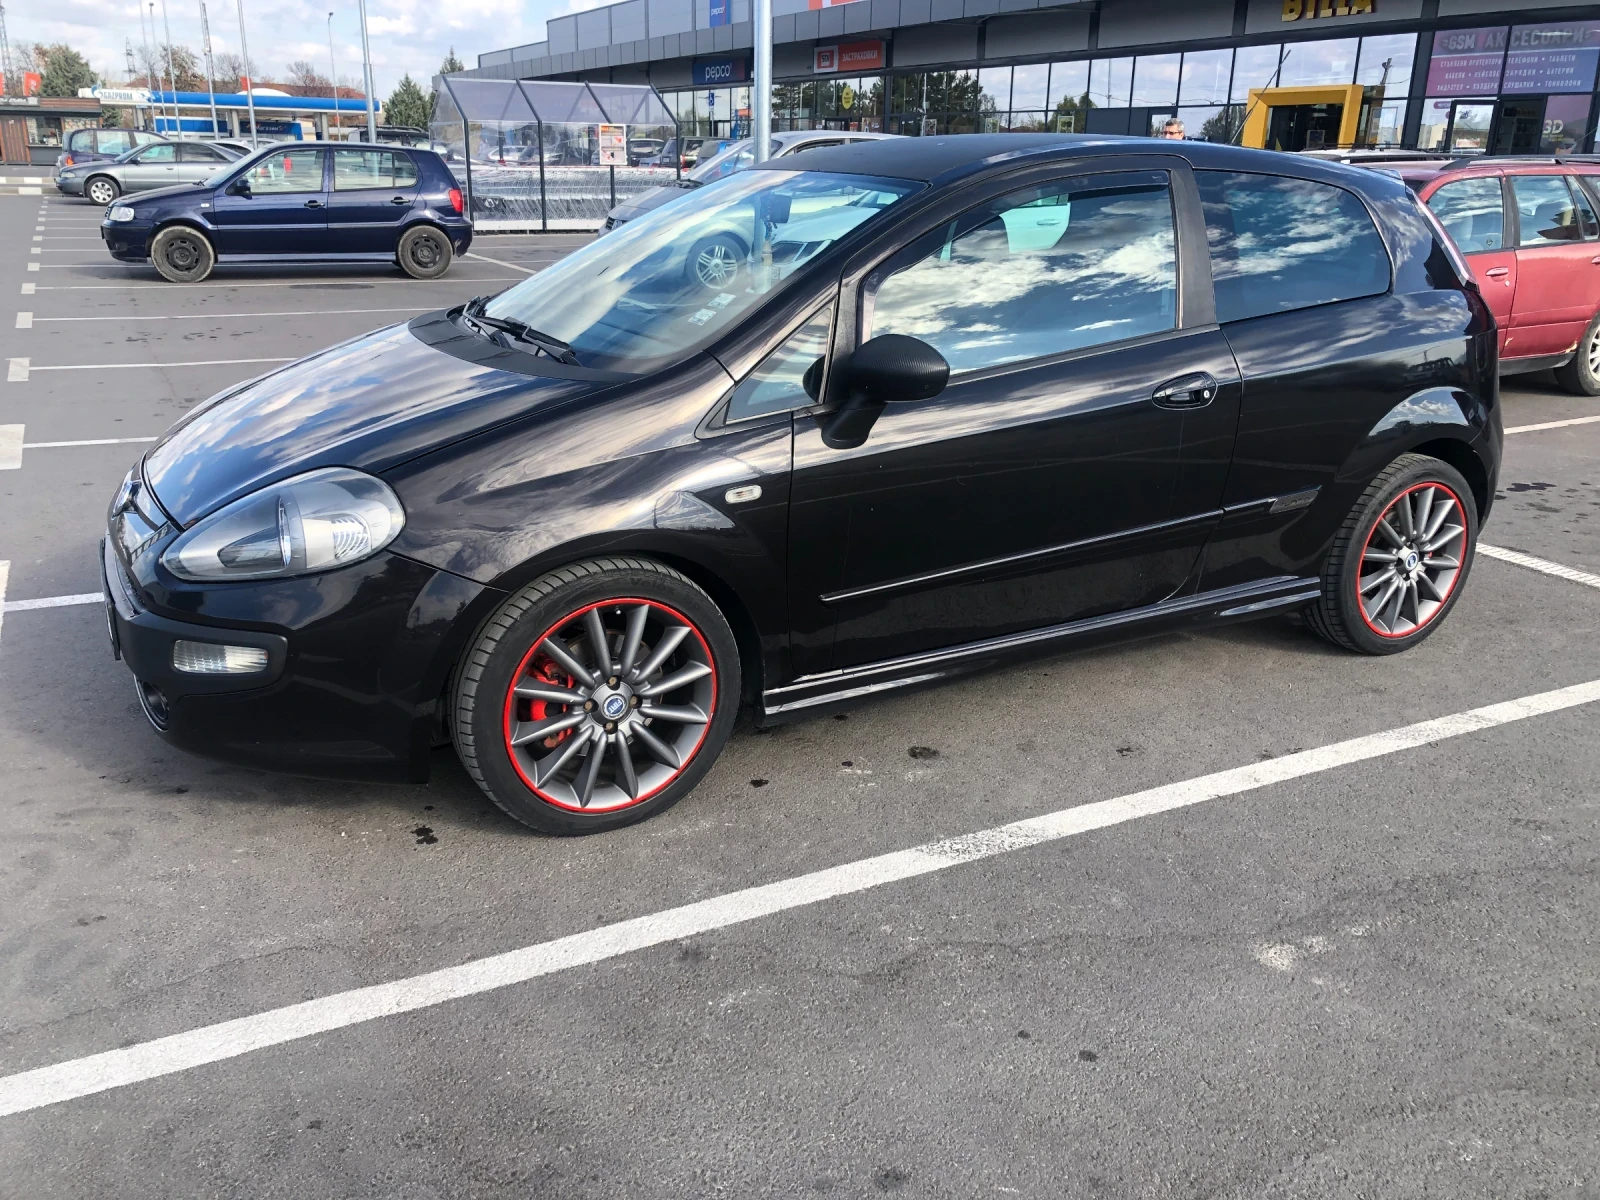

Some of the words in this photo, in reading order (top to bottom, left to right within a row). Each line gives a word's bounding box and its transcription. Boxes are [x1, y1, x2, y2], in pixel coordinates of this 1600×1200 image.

[711, 7, 725, 16] pepco
[1448, 34, 1476, 50] GSM
[842, 50, 878, 62] ЗАСТРАХОВКИ
[705, 64, 731, 81] pepco
[104, 91, 133, 100] GAZPROM
[1543, 119, 1564, 133] 3D
[608, 698, 623, 713] FIAT
